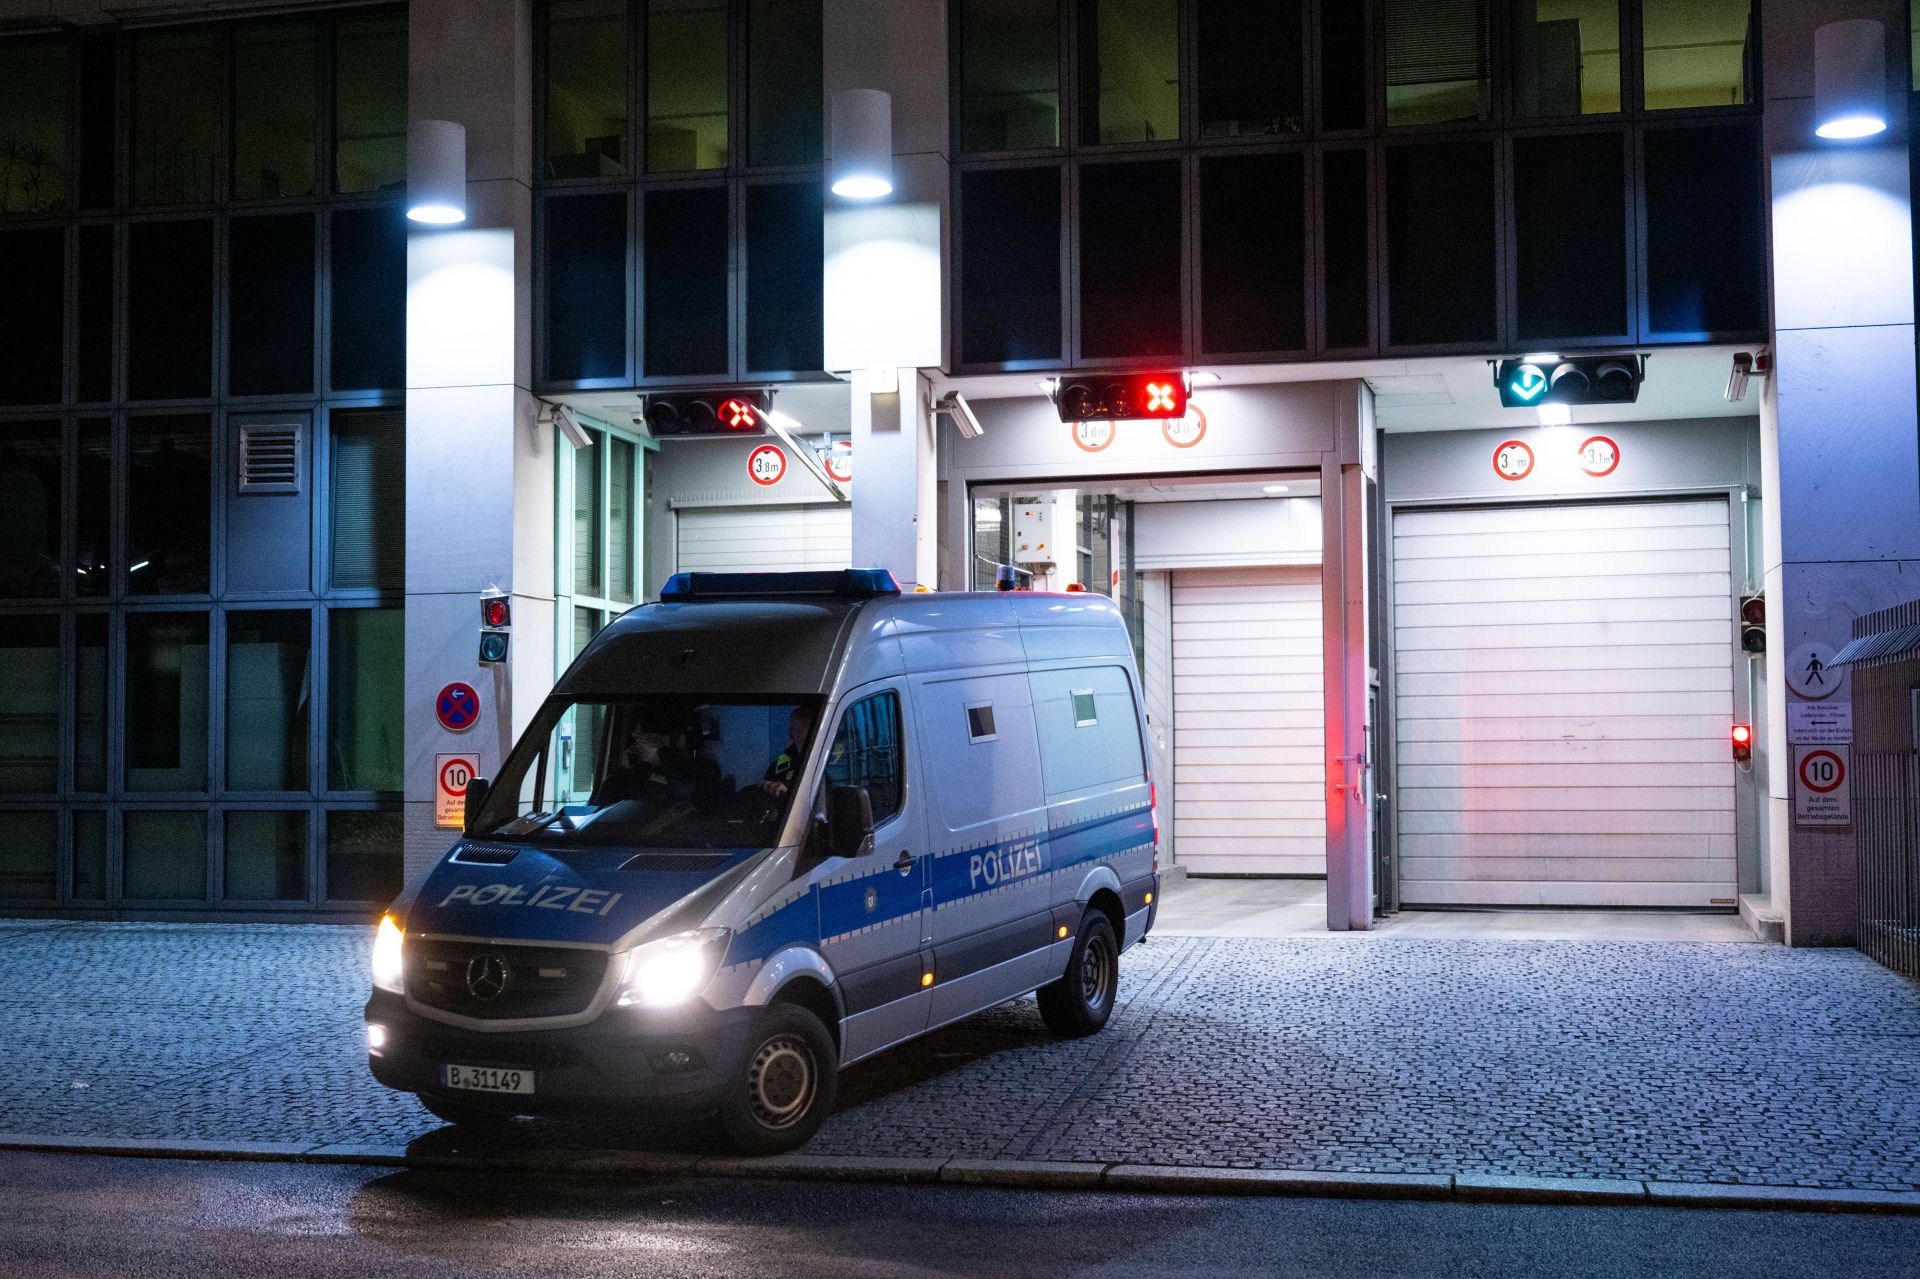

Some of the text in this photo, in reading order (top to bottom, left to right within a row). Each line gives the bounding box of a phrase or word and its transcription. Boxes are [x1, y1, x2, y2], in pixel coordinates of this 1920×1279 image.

[449, 769, 466, 786] 10
[1812, 762, 1833, 781] 10
[1797, 813, 1849, 821] Betriebsgelände
[969, 839, 1042, 890] POLIZEI
[438, 883, 624, 916] POLIZEI
[451, 1067, 521, 1090] B 31149
